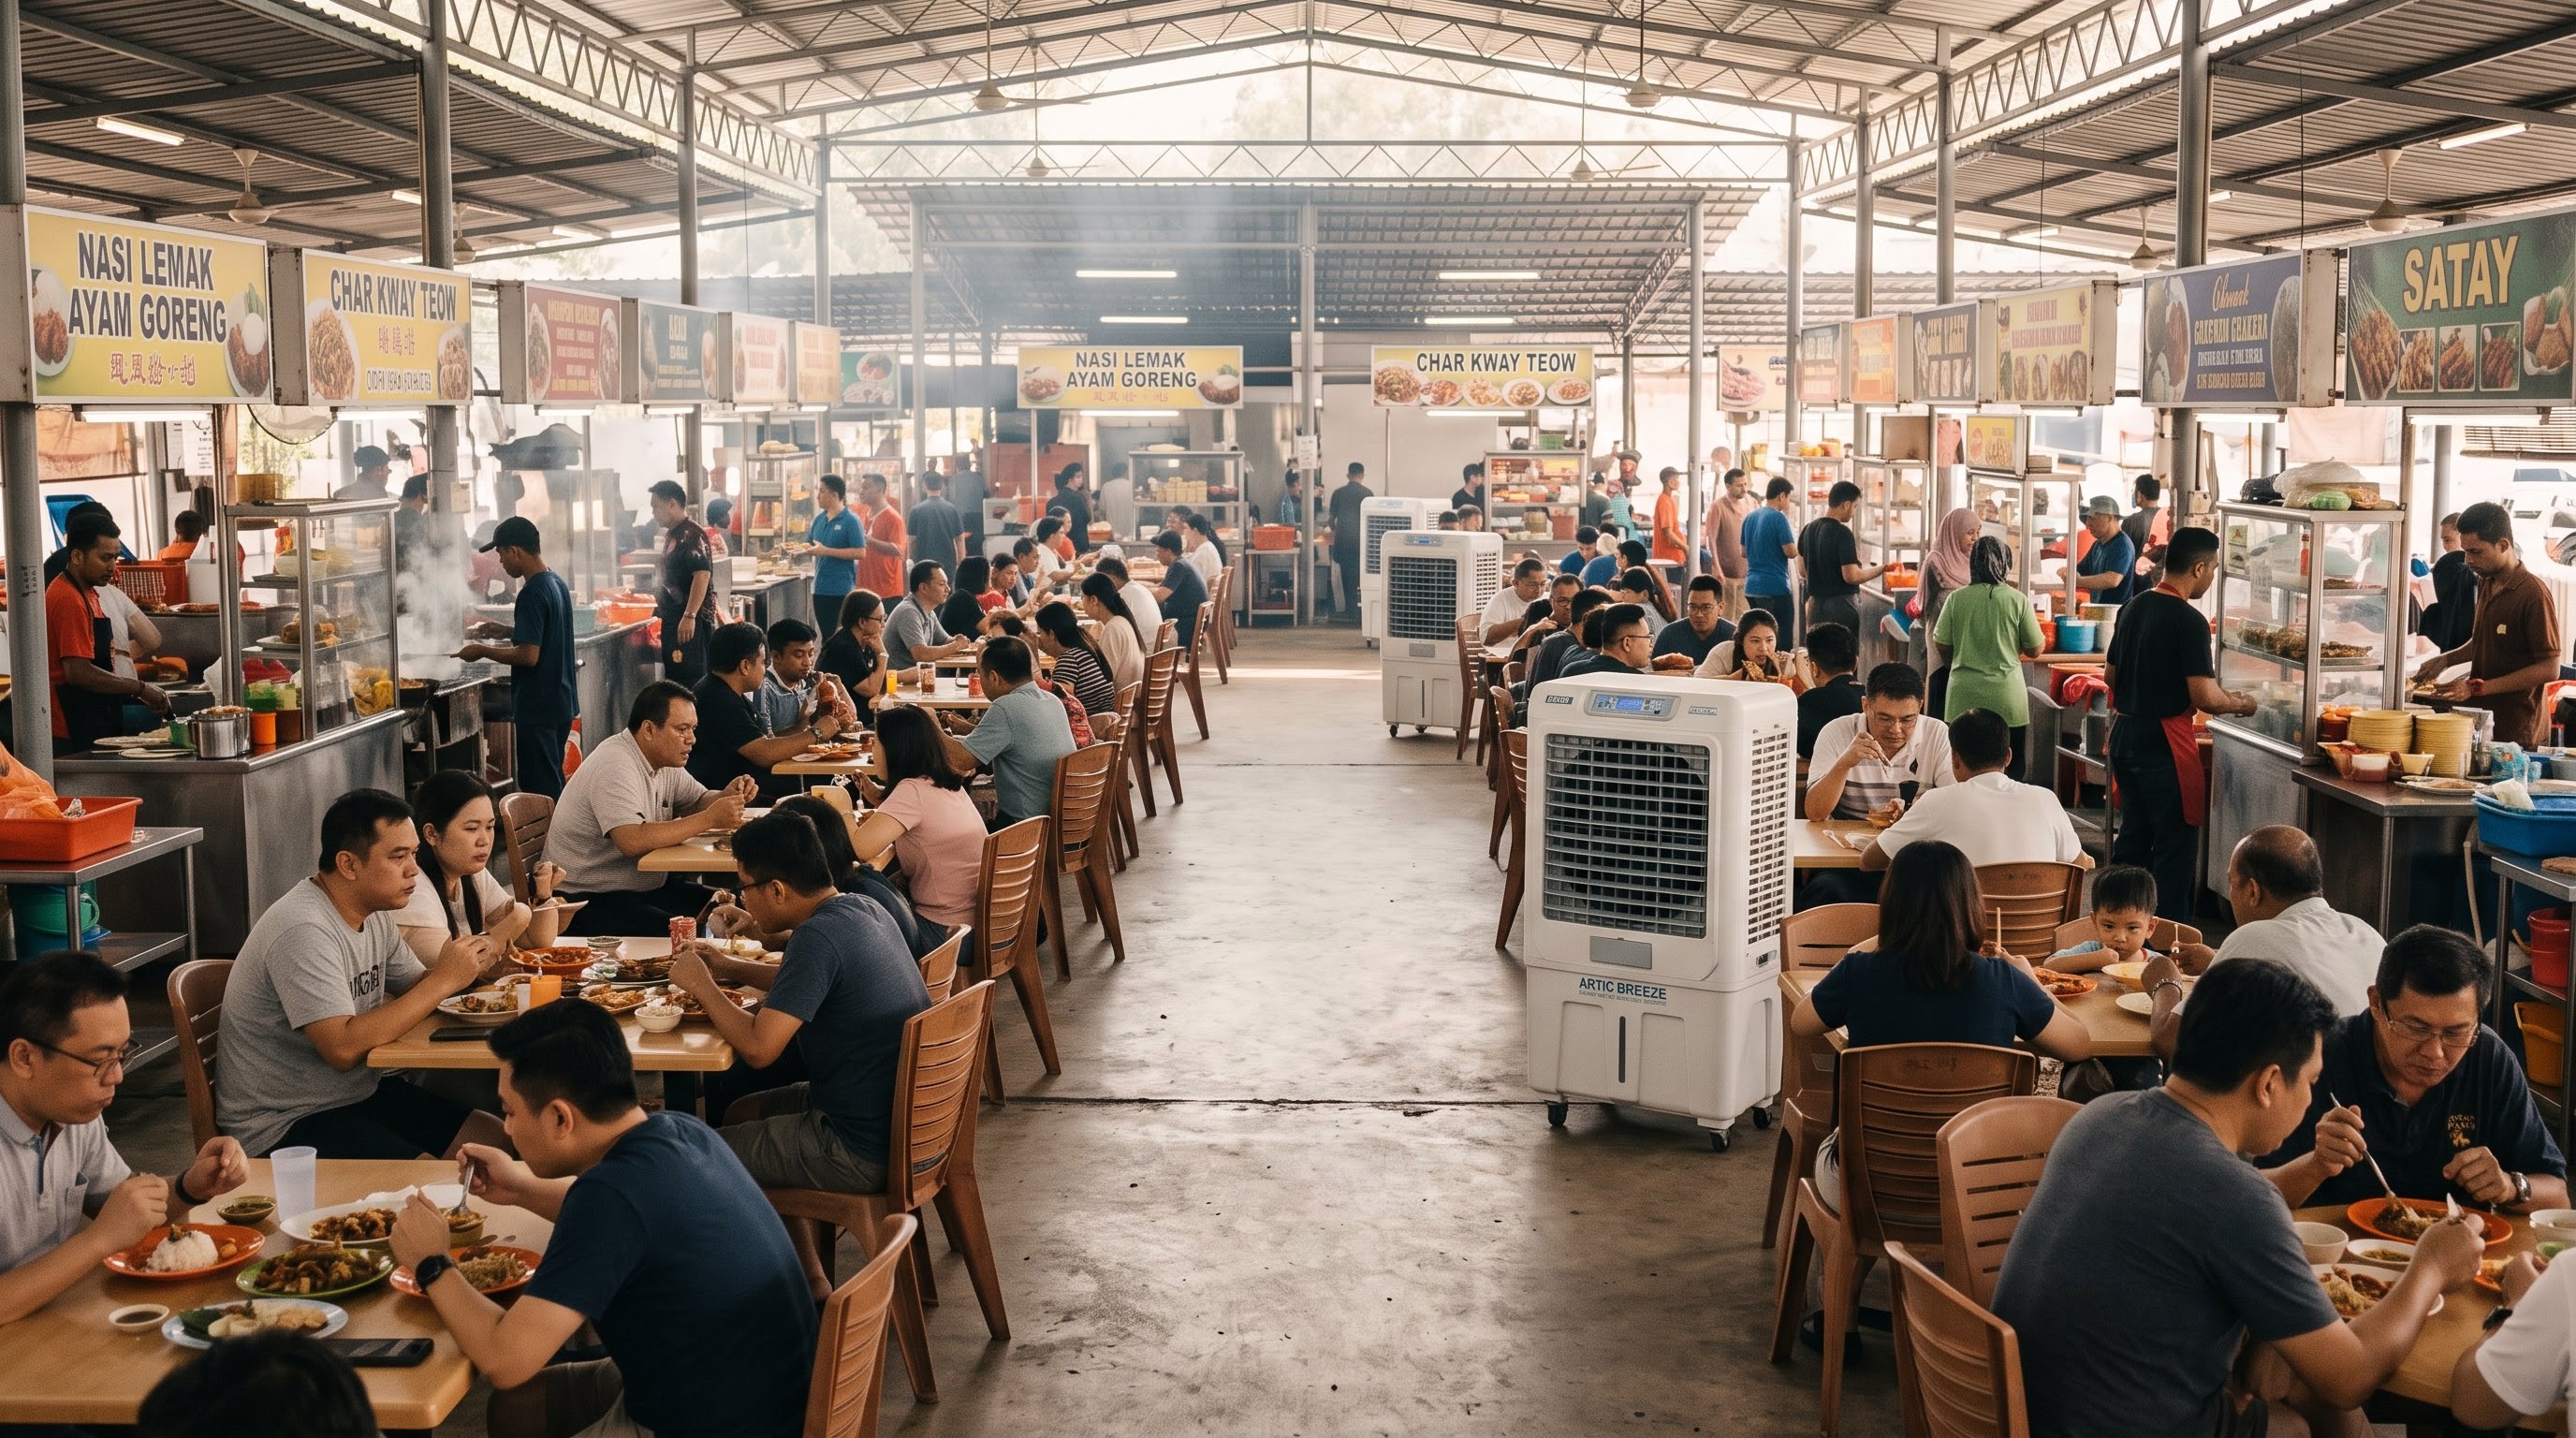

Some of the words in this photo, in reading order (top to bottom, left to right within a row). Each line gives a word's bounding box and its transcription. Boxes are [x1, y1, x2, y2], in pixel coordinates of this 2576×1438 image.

[78, 232, 133, 283] NASI
[140, 241, 214, 291] LEMAK
[2402, 234, 2519, 313] SATAY
[330, 269, 374, 314] CHAR
[376, 275, 417, 318] KWAY
[420, 281, 457, 321] TEOW
[68, 288, 132, 338] AYAM
[140, 293, 227, 344] GORENG
[1076, 351, 1117, 368] NASI
[1124, 351, 1186, 368] LEMAK
[1416, 352, 1465, 373] CHAR
[1471, 352, 1521, 373] KWAY
[1526, 352, 1576, 373] TEOW
[1066, 371, 1115, 388] AYAM
[1120, 371, 1197, 388] GORENG
[1578, 976, 1615, 993] ARTIC
[1617, 982, 1667, 1000] BREEZE
